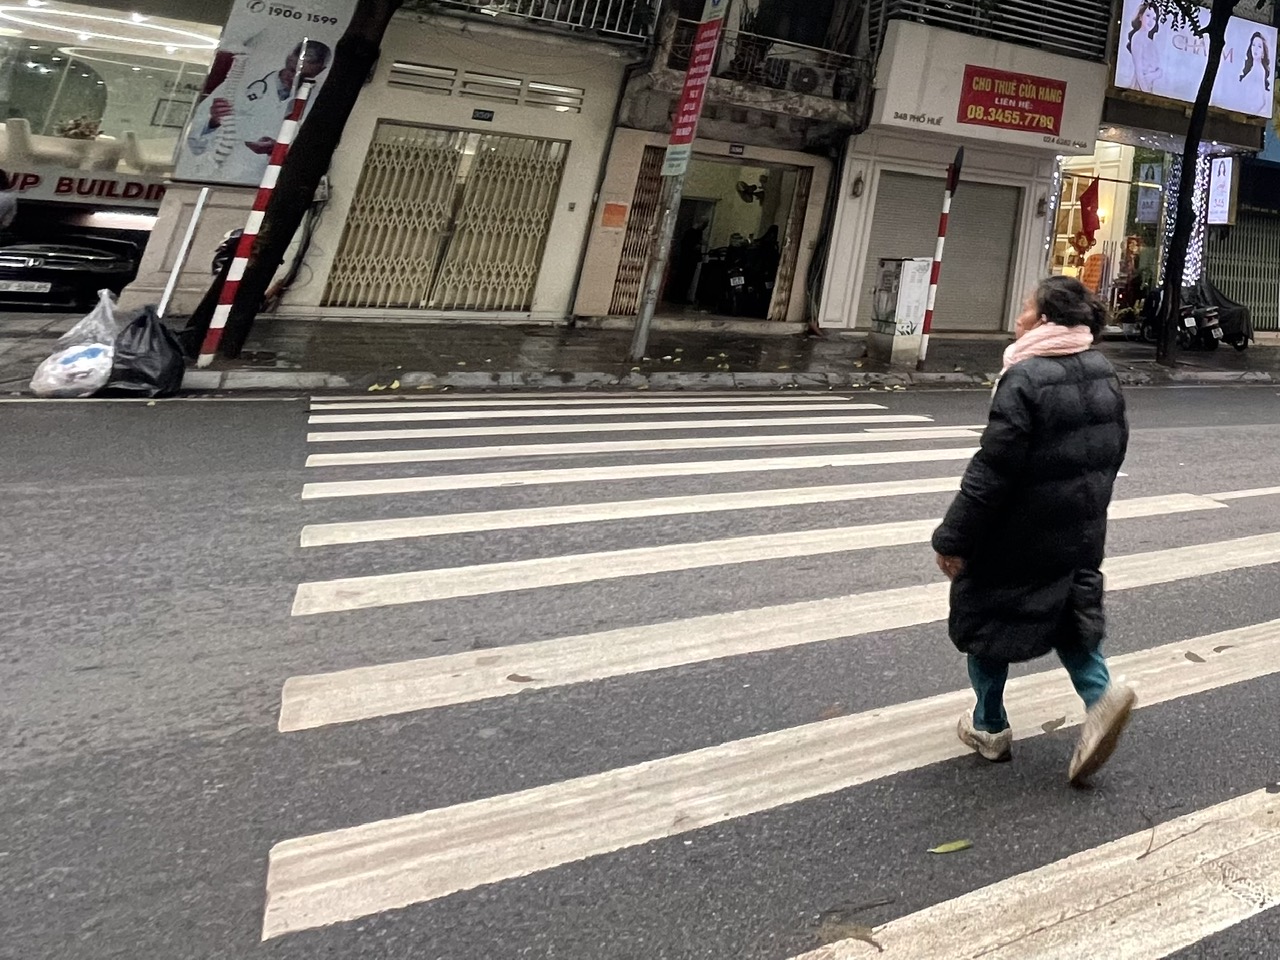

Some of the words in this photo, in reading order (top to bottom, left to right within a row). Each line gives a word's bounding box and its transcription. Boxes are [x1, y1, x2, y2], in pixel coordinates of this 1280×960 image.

[268, 6, 303, 21] 1900
[306, 13, 338, 27] 1599
[1172, 34, 1234, 64] CHAM
[972, 76, 993, 92] CHO
[994, 78, 1017, 97] THUÊ
[995, 96, 1016, 107] LIÊN
[893, 111, 908, 121] 348
[909, 113, 927, 124] PHỐ
[927, 116, 944, 127] HUẾ
[966, 104, 1055, 130] 08.3455.7789
